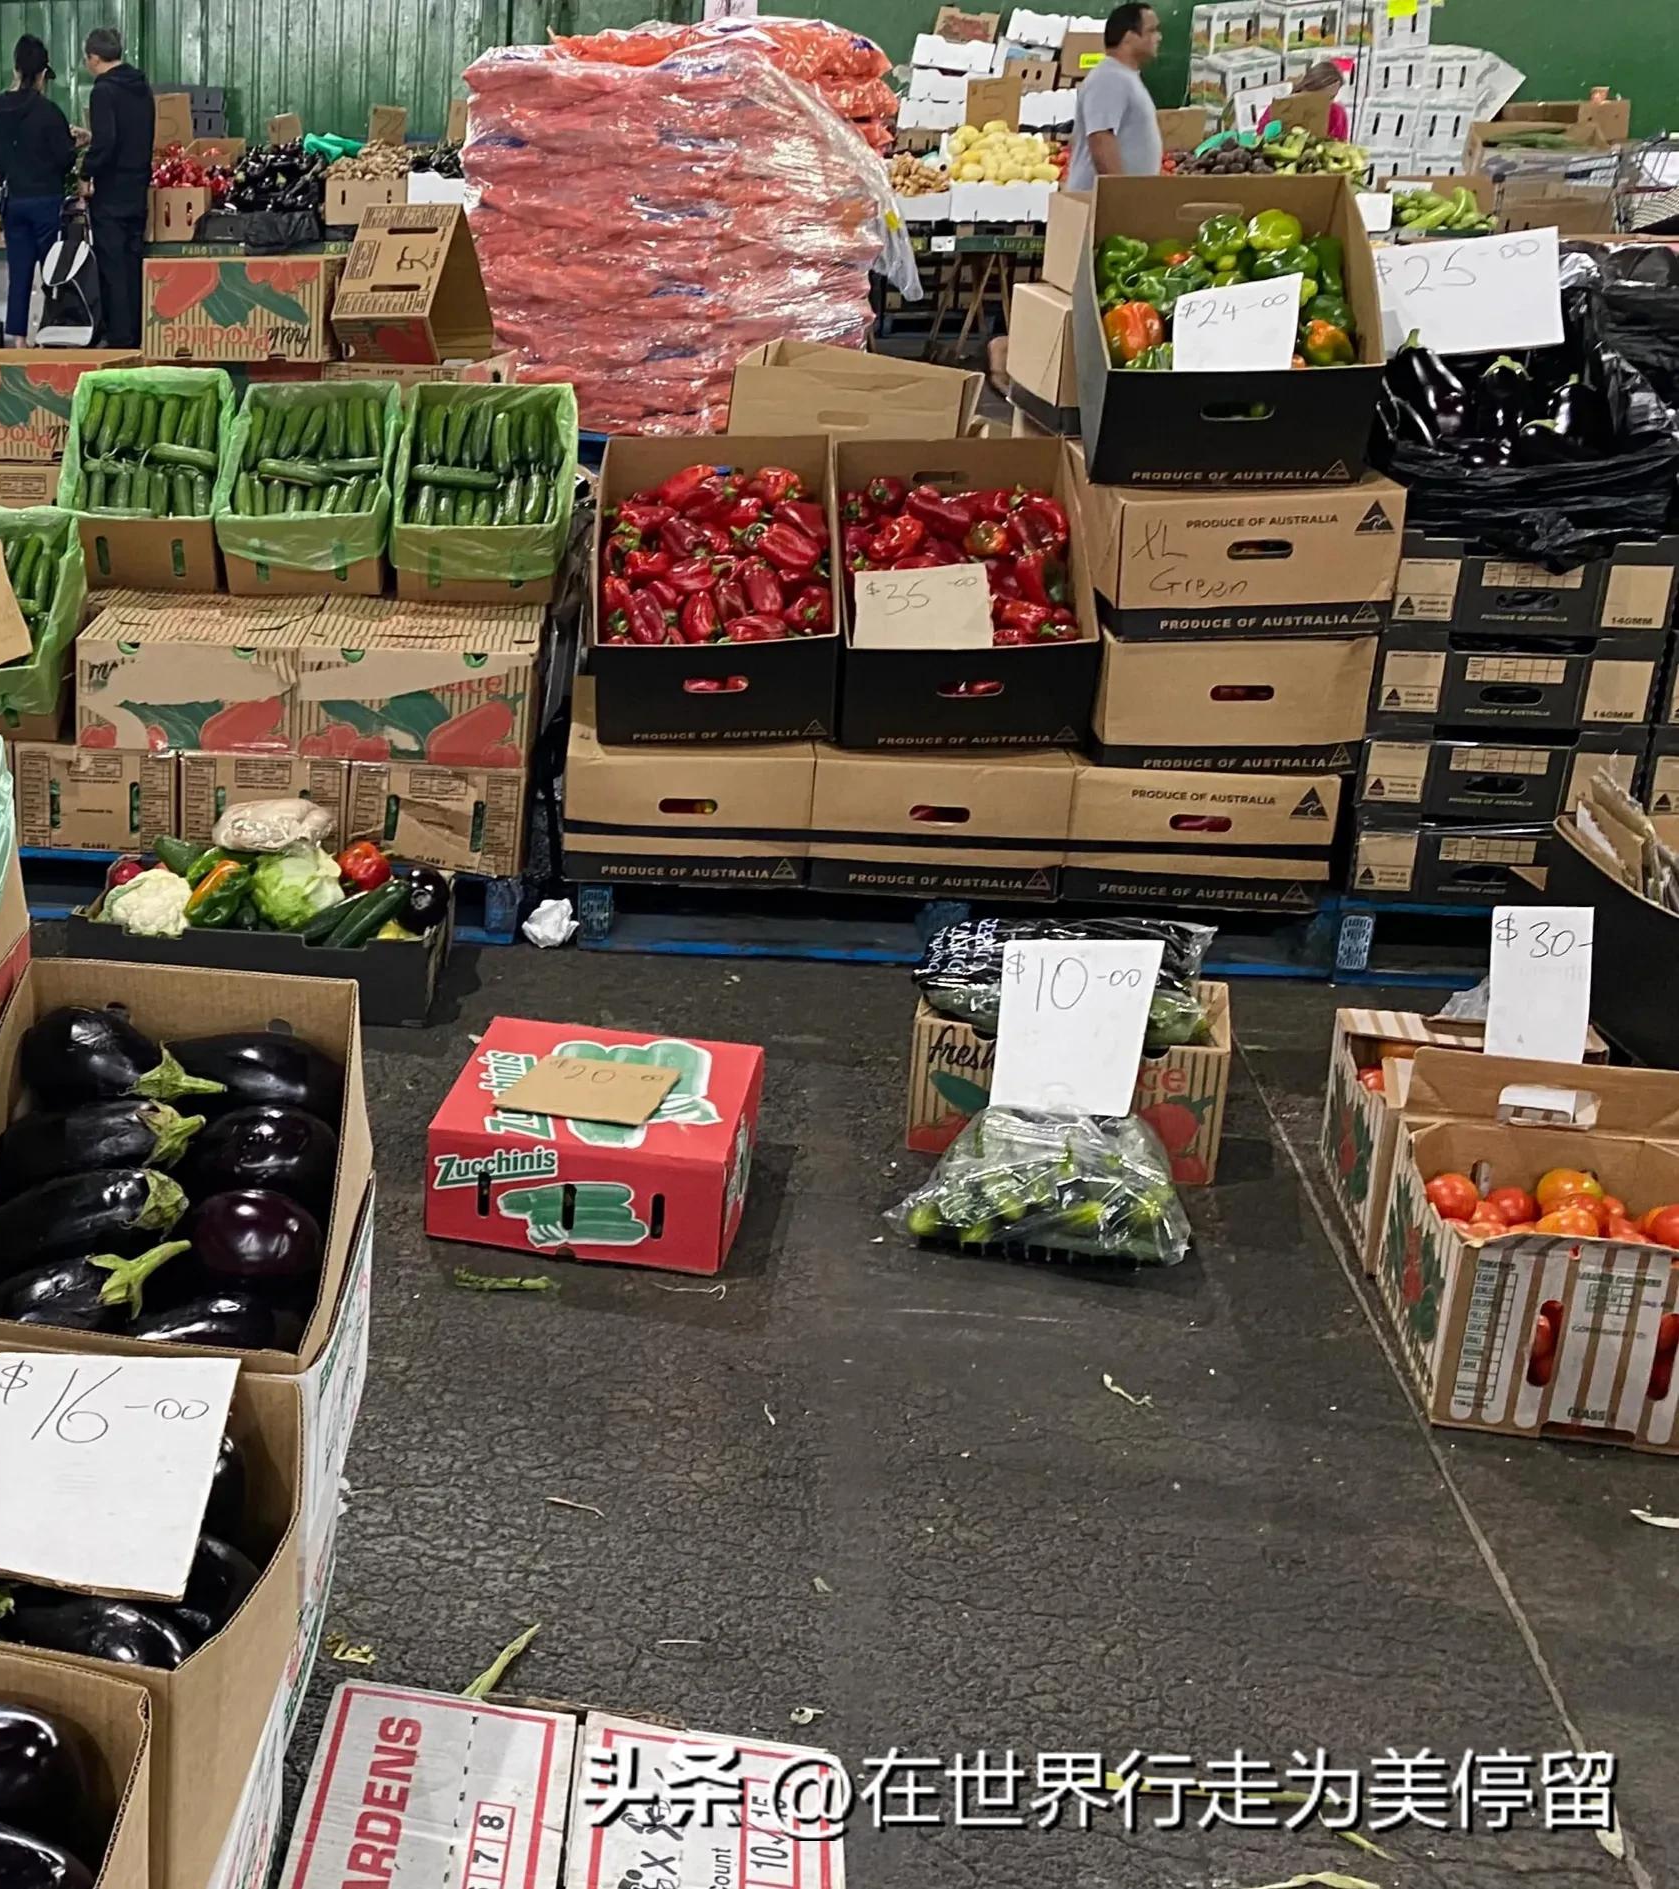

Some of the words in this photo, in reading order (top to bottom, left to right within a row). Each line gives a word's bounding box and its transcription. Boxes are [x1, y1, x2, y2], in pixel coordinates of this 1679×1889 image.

[1132, 472, 1203, 481] PRODUCE
[1208, 472, 1228, 481] OF
[1233, 470, 1319, 481] AUSTRALIA
[1186, 517, 1245, 529] PRODUCE
[1248, 517, 1266, 528] OF
[1270, 514, 1339, 527] AUSTRALIA
[1131, 519, 1189, 560] XL
[1149, 566, 1249, 599] Green
[1159, 618, 1231, 630] PRODUCE
[1237, 617, 1257, 629] OF
[1262, 613, 1350, 628] AUSTRALIA
[633, 730, 697, 741] PRODUCE
[700, 730, 720, 740] OF
[723, 728, 801, 740] AUSTRALIA
[877, 736, 939, 746] PRODUCE
[947, 736, 968, 746] OF
[971, 734, 1051, 746] AUSTRALIA
[1143, 758, 1212, 769] PRODUCE
[1217, 758, 1236, 769] OF
[1242, 758, 1326, 769] AUSTRALIA
[1131, 788, 1184, 800] PRODUCE
[1191, 792, 1206, 801] OF
[1210, 793, 1277, 805] AUSTRALIA
[601, 864, 666, 877] PRODUCE
[670, 866, 689, 877] OF
[692, 866, 770, 879] AUSTRALIA
[849, 872, 915, 885] PRODUCE
[920, 875, 939, 886] OF
[943, 876, 1023, 890] AUSTRALIA
[1098, 882, 1168, 897] PRODUCE
[1172, 887, 1193, 897] OF
[1198, 888, 1279, 902] AUSTRALIA
[434, 1147, 558, 1188] Zucchinis
[478, 1815, 505, 1831] 8
